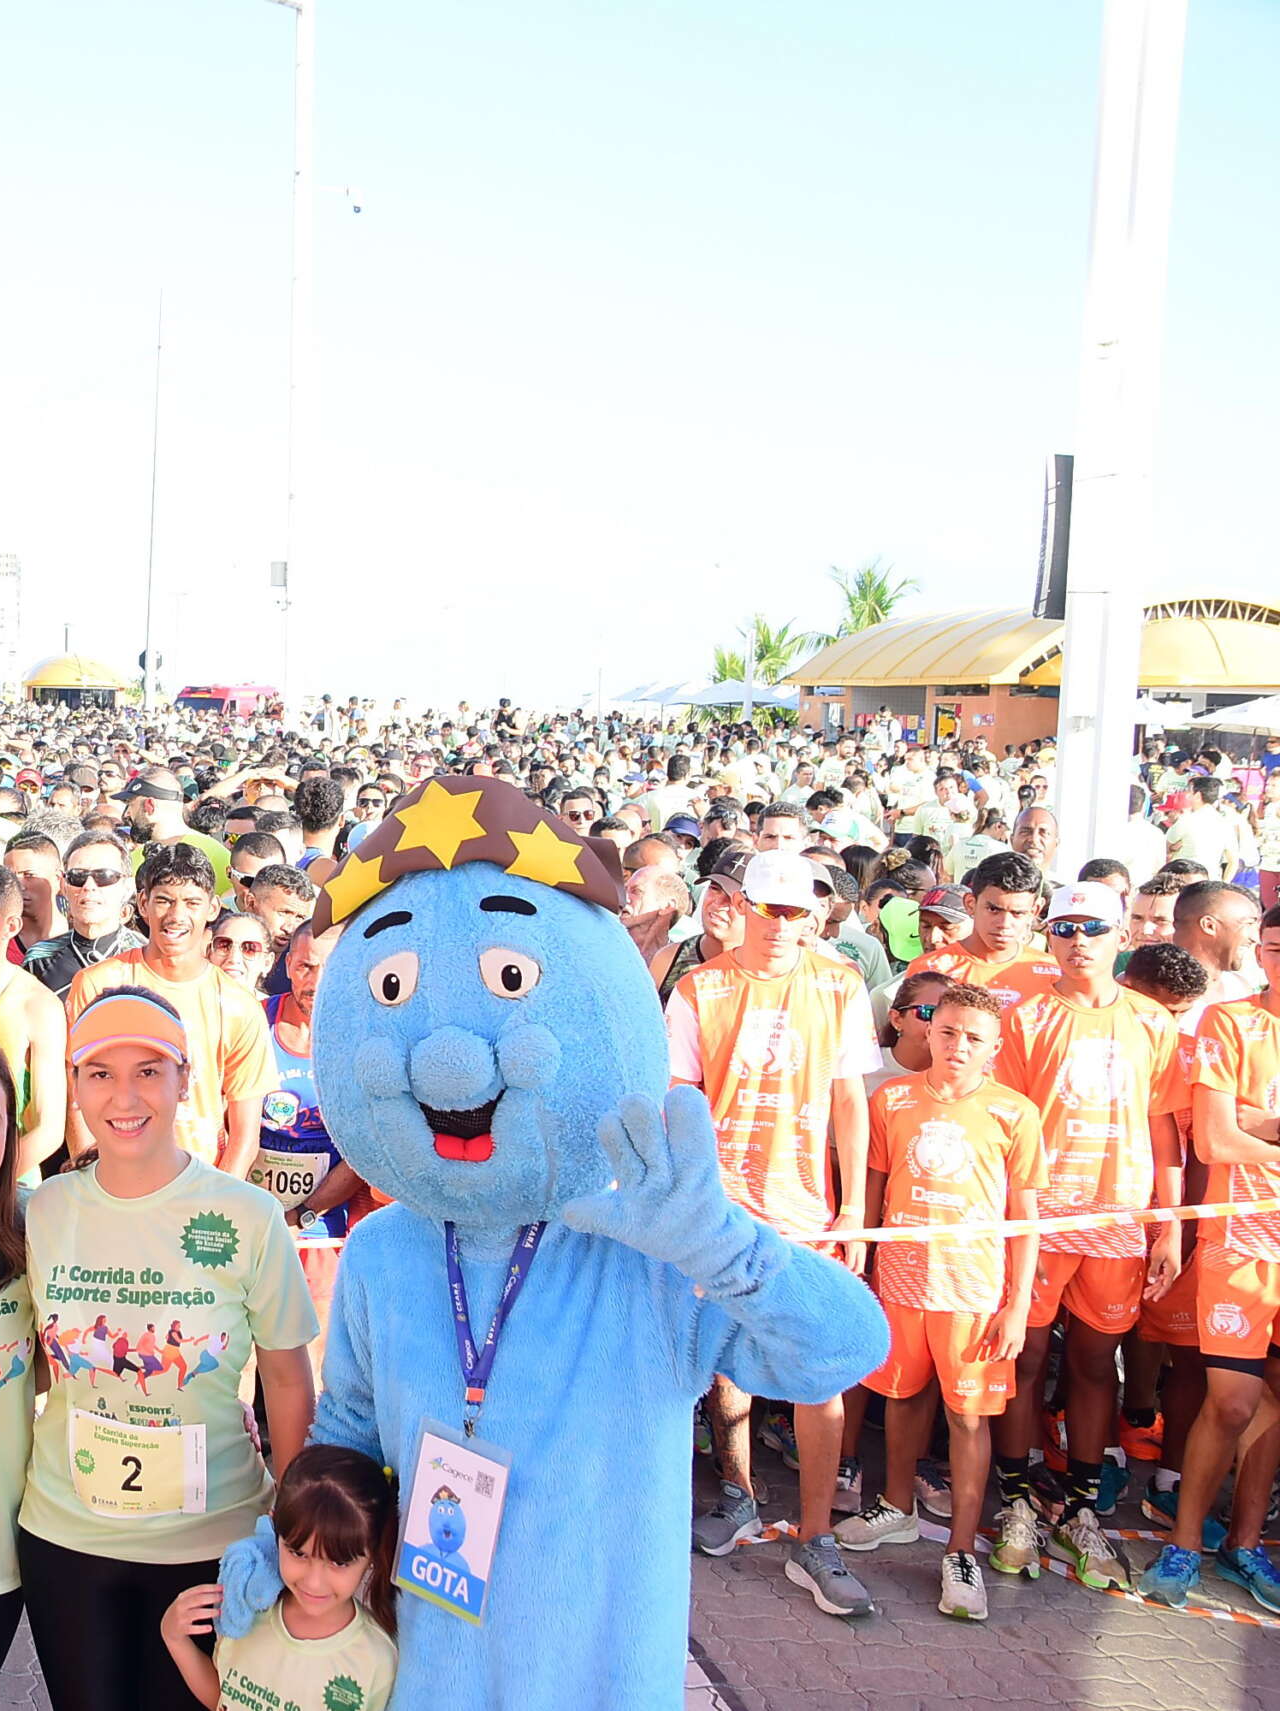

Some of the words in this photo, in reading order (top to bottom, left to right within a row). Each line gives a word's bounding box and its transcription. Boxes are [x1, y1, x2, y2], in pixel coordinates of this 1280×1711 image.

[264, 1169, 314, 1195] 1069
[69, 1265, 135, 1285] Corrida
[139, 1266, 164, 1285] do
[46, 1283, 112, 1304] Esporte
[116, 1286, 217, 1309] Superação
[128, 1404, 172, 1415] ESPORTE
[94, 1431, 119, 1444] Esporte
[120, 1439, 160, 1450] Superação
[103, 1426, 128, 1440] Corrida
[129, 1432, 139, 1441] do
[121, 1455, 143, 1492] 2
[411, 1554, 470, 1605] GOTA
[220, 1680, 264, 1711] Esporte
[239, 1674, 281, 1707] Corrida
